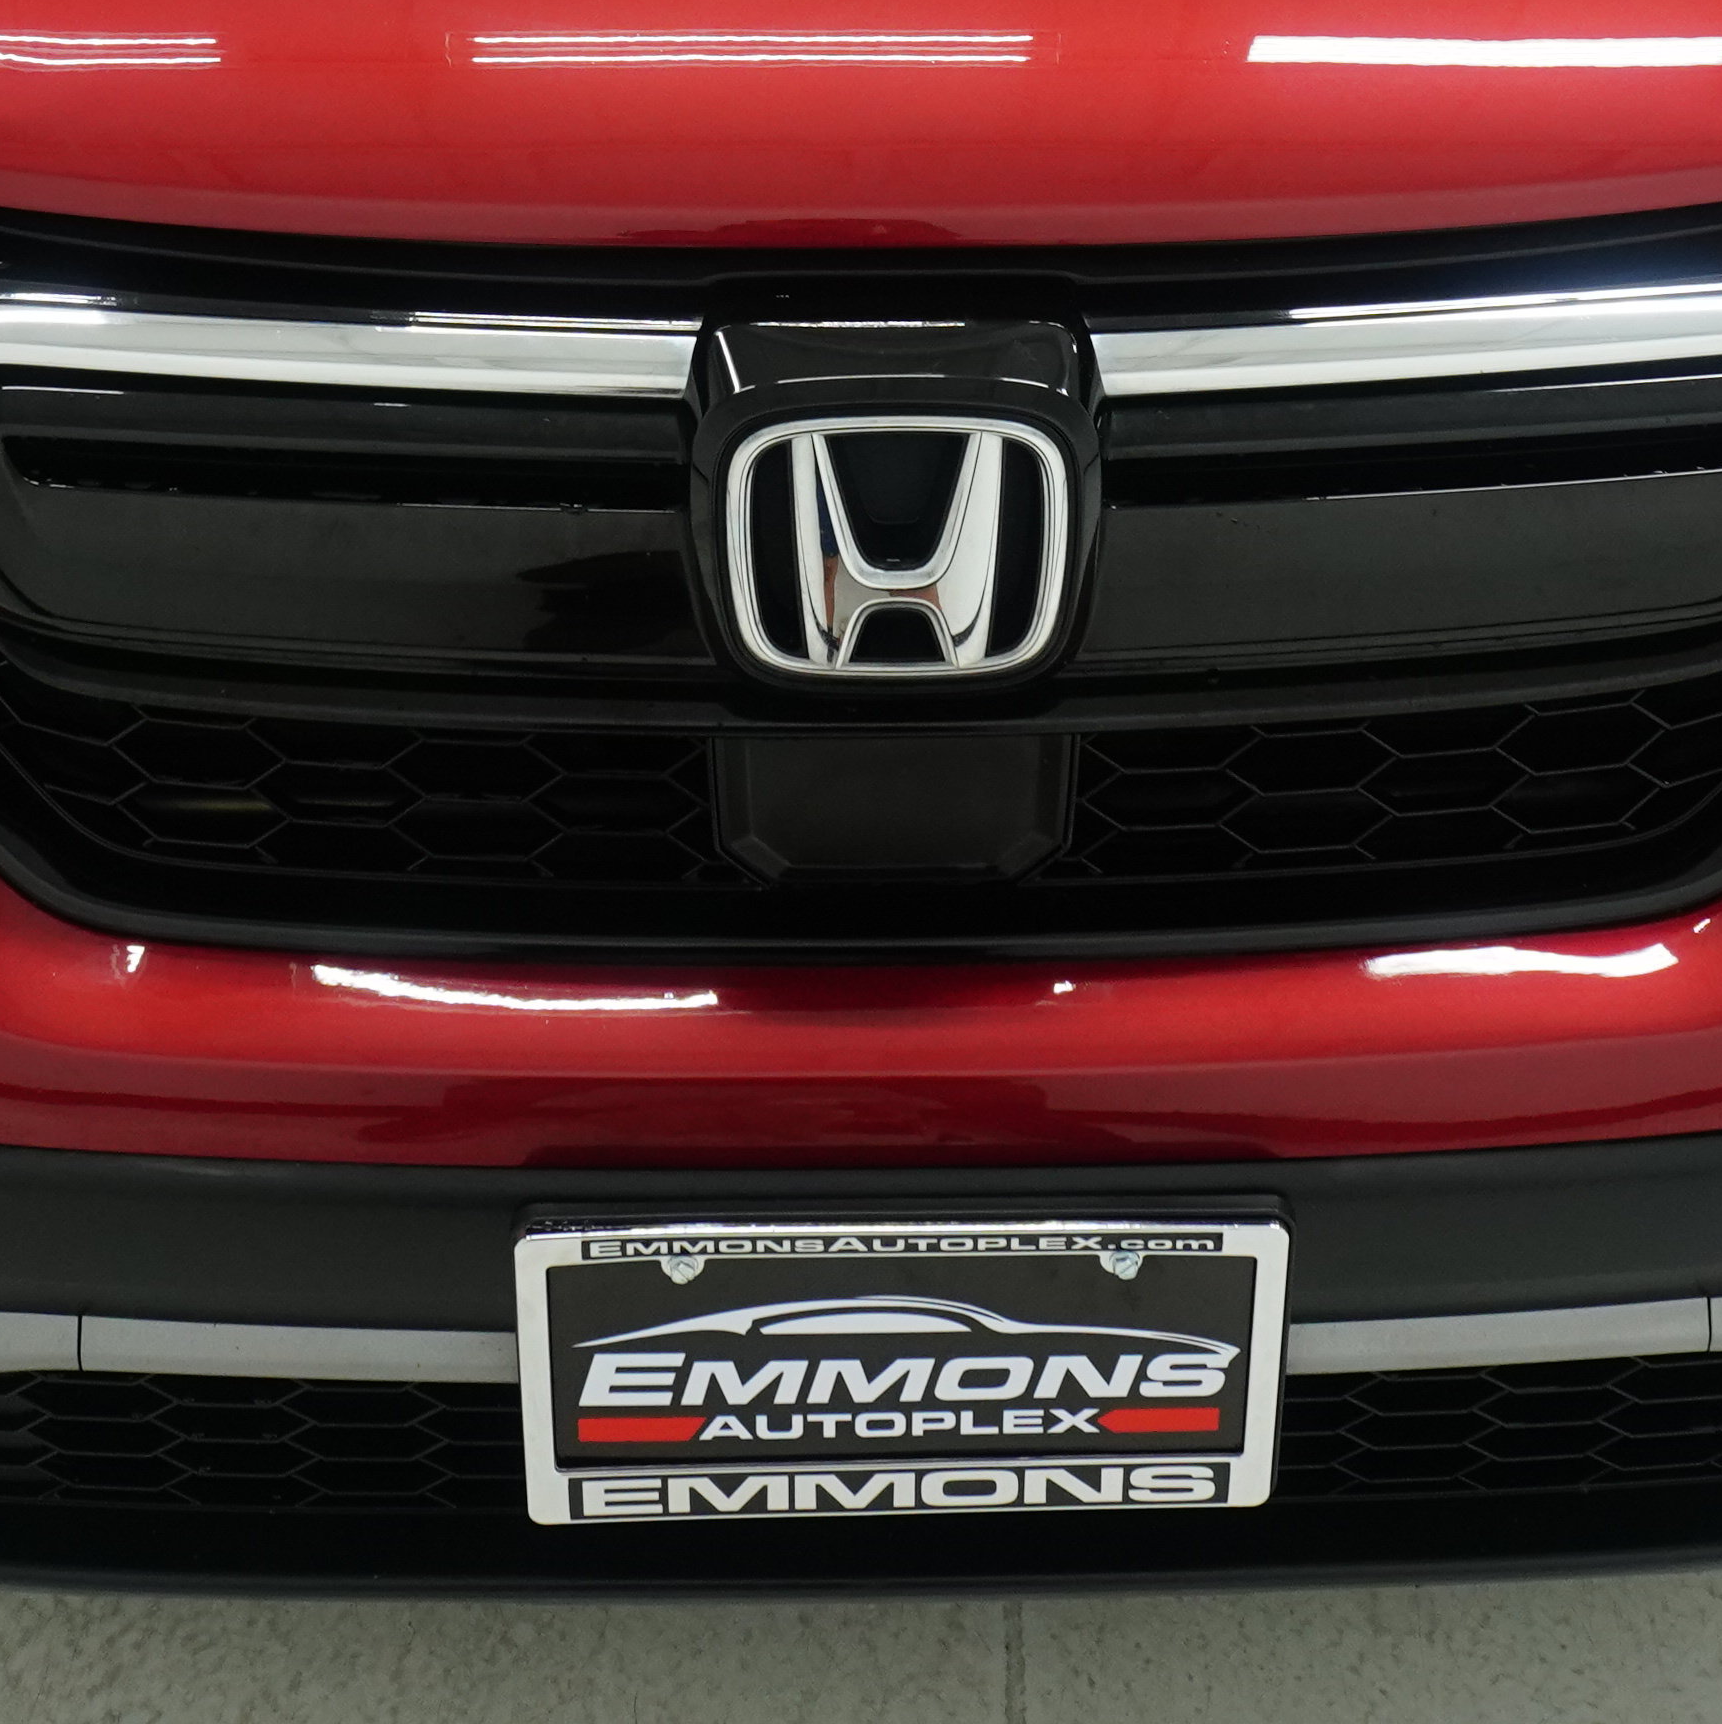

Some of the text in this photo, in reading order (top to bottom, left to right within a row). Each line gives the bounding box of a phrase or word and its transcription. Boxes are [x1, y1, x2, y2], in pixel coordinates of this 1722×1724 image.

[578, 1352, 1233, 1407] EMMONS
[699, 1408, 1100, 1441] AUTOPLEX
[581, 1465, 1216, 1517] EMMONS
